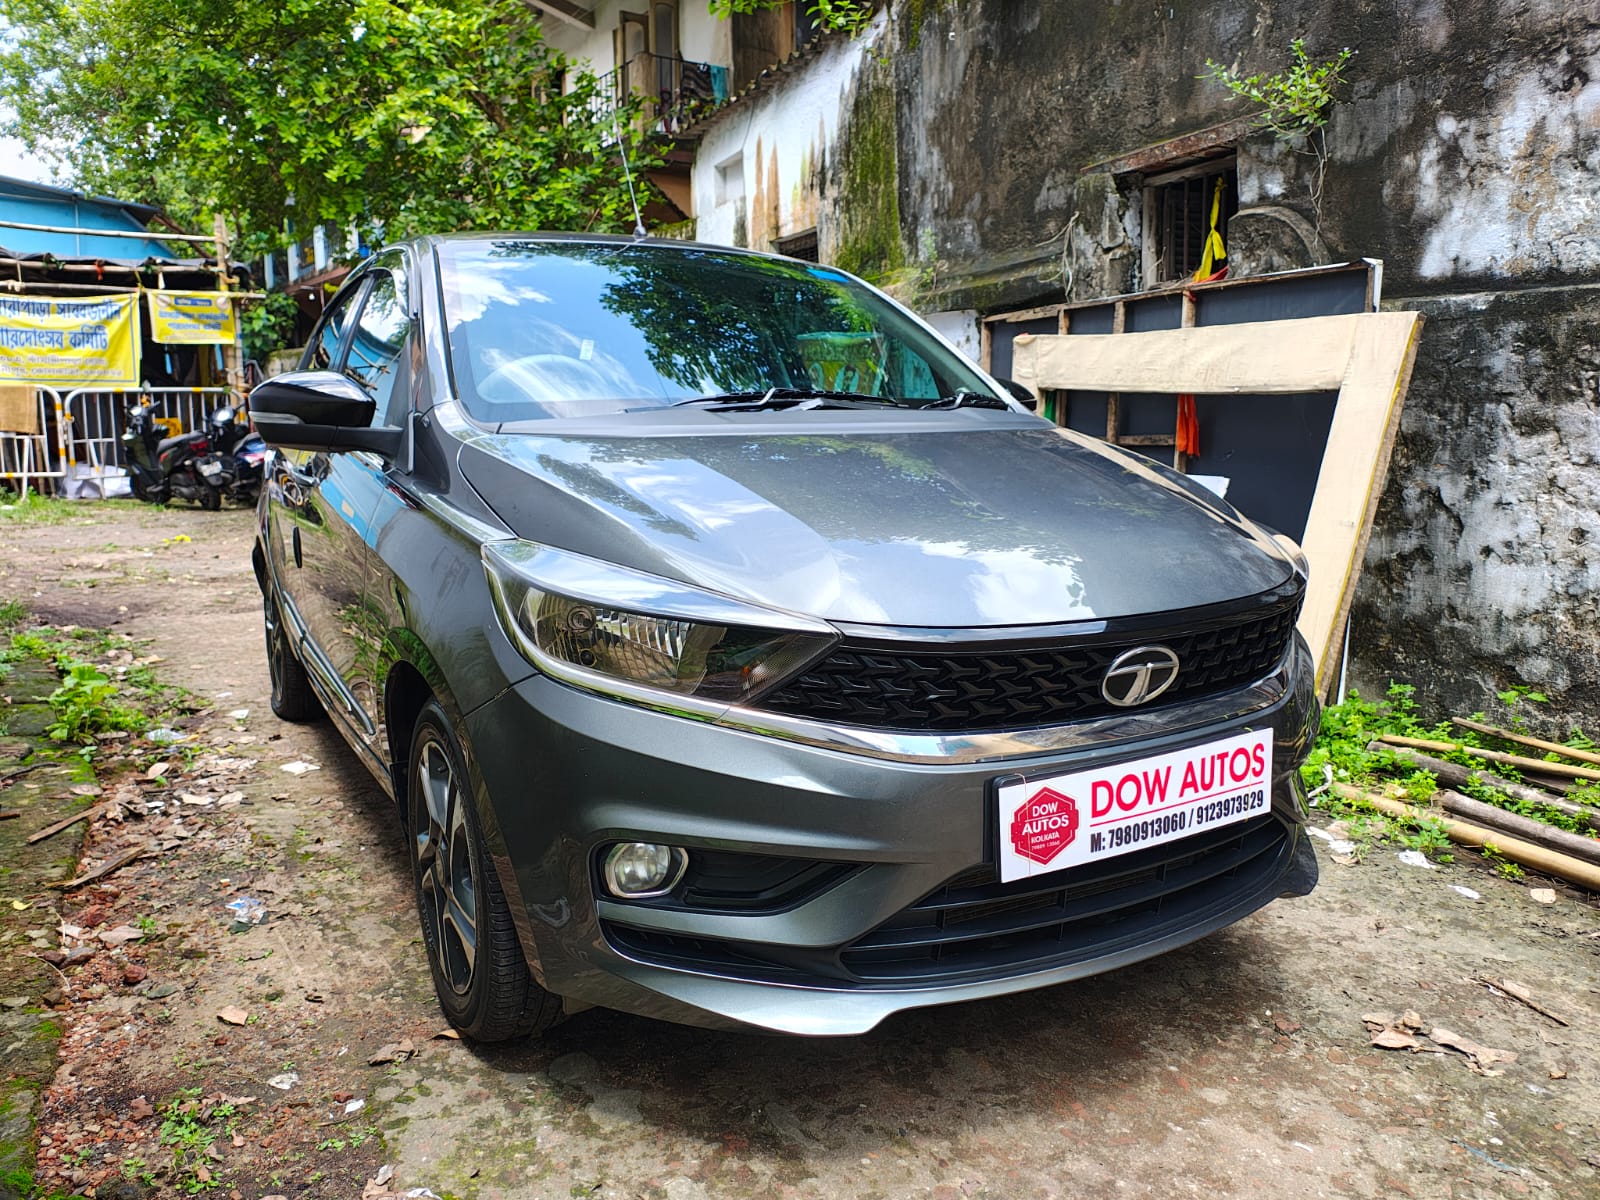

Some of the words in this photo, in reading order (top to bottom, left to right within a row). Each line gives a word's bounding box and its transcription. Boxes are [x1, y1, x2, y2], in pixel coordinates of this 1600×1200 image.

[1091, 766, 1172, 819] DOW
[1178, 742, 1265, 798] AUTOS
[1032, 801, 1059, 817] DOW
[1021, 814, 1070, 836] AUTOS
[1090, 831, 1106, 853] M:
[1108, 811, 1186, 849] 7980913060
[1196, 789, 1264, 825] 9123973929
[1031, 830, 1060, 844] KOLKATA
